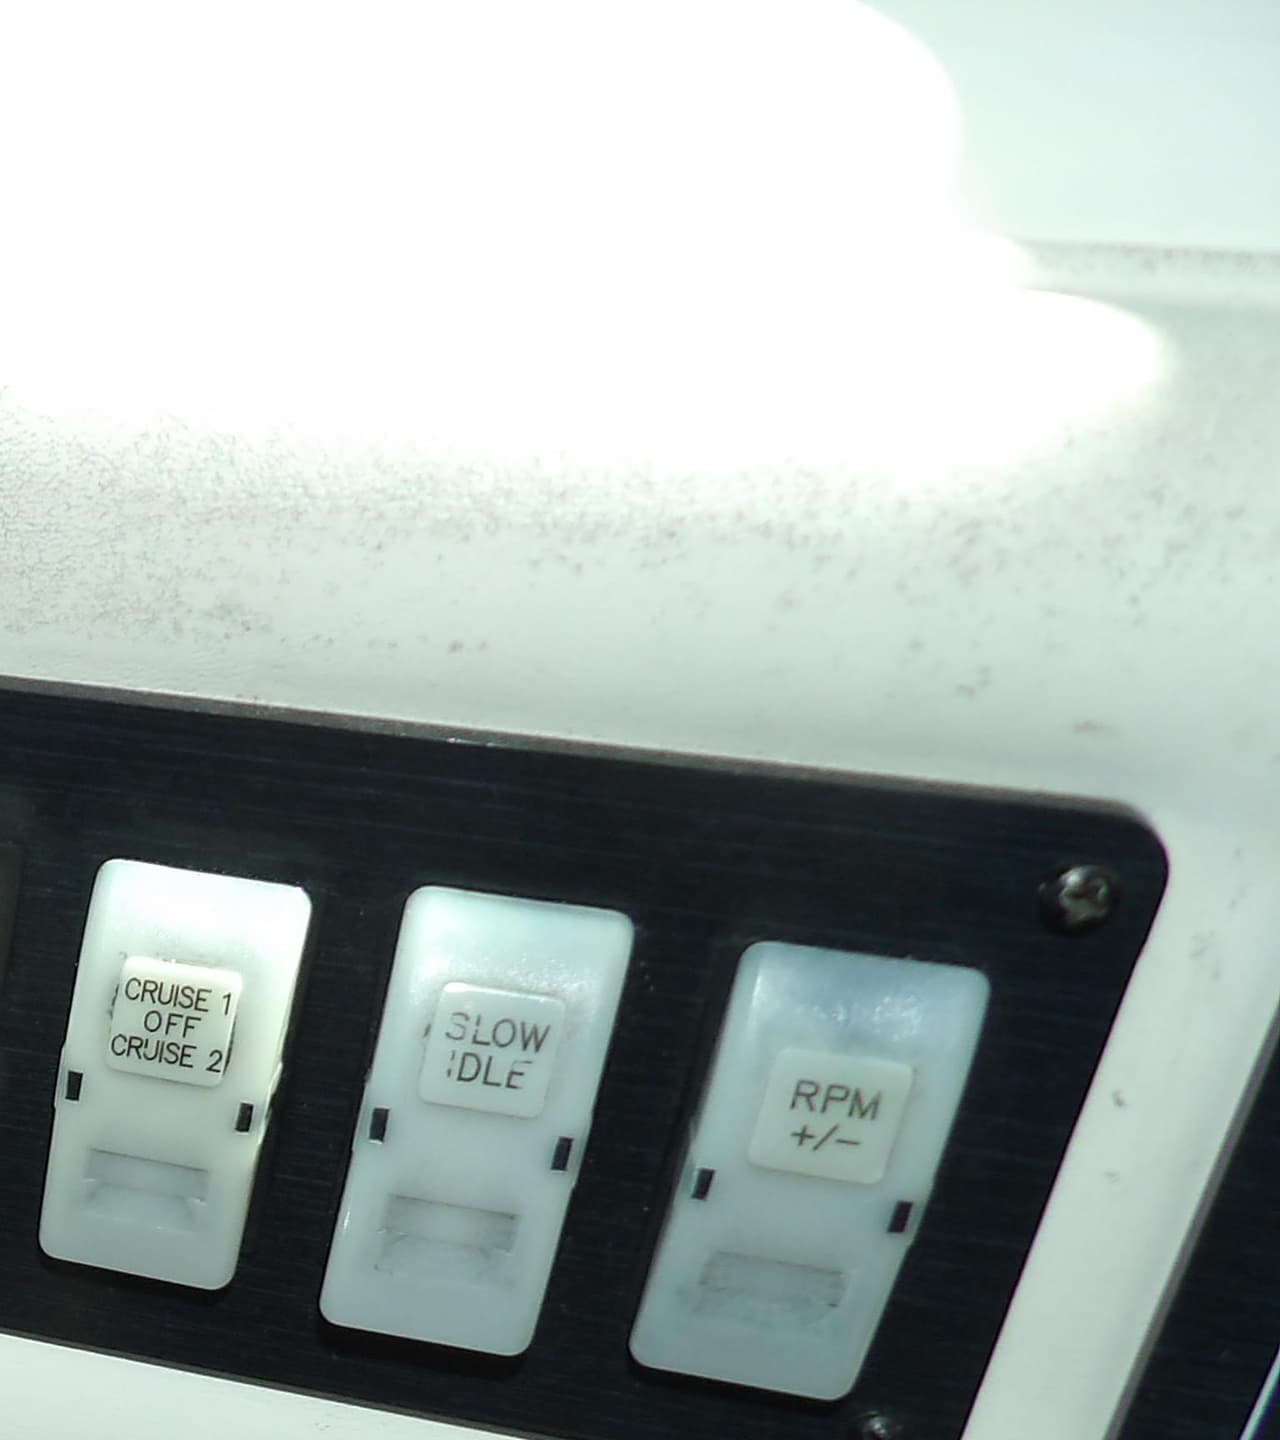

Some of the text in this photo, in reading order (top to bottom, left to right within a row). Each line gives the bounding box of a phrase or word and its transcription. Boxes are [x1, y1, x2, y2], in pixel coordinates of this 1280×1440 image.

[125, 977, 232, 1016] CRUISE 1
[143, 1009, 202, 1039] OFF
[445, 1011, 552, 1054] SLOW
[111, 1033, 223, 1073] CRUISE 2
[446, 1049, 533, 1090] IDLE
[790, 1079, 883, 1121] RPM
